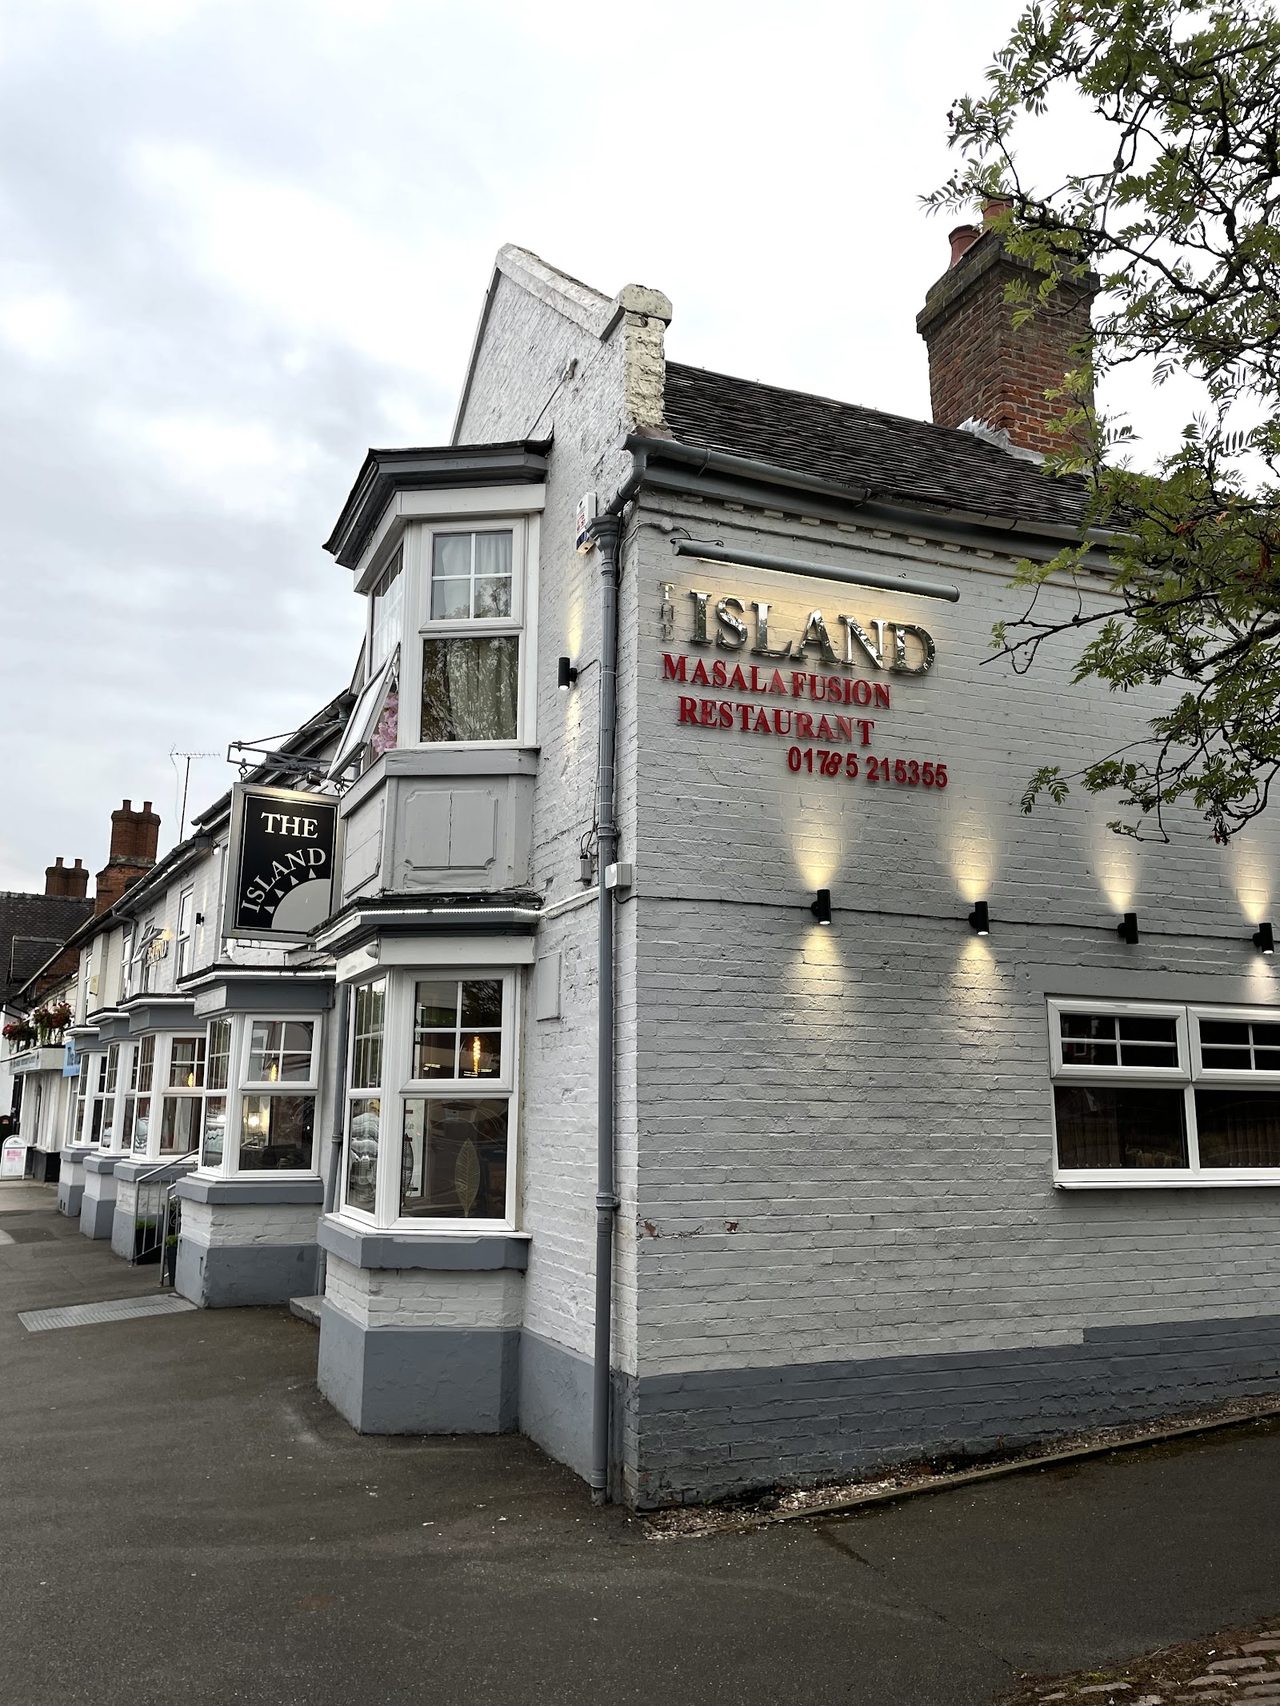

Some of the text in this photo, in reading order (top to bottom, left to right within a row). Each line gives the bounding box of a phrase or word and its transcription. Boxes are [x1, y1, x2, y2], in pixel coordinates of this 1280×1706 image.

[658, 583, 675, 641] THE
[690, 589, 935, 674] ISLAND
[661, 652, 892, 710] MASALA FUSION
[678, 696, 875, 745] RESTAURANT
[787, 745, 949, 789] 01785 215355
[261, 811, 318, 838] THE
[241, 847, 326, 913] ISLAND
